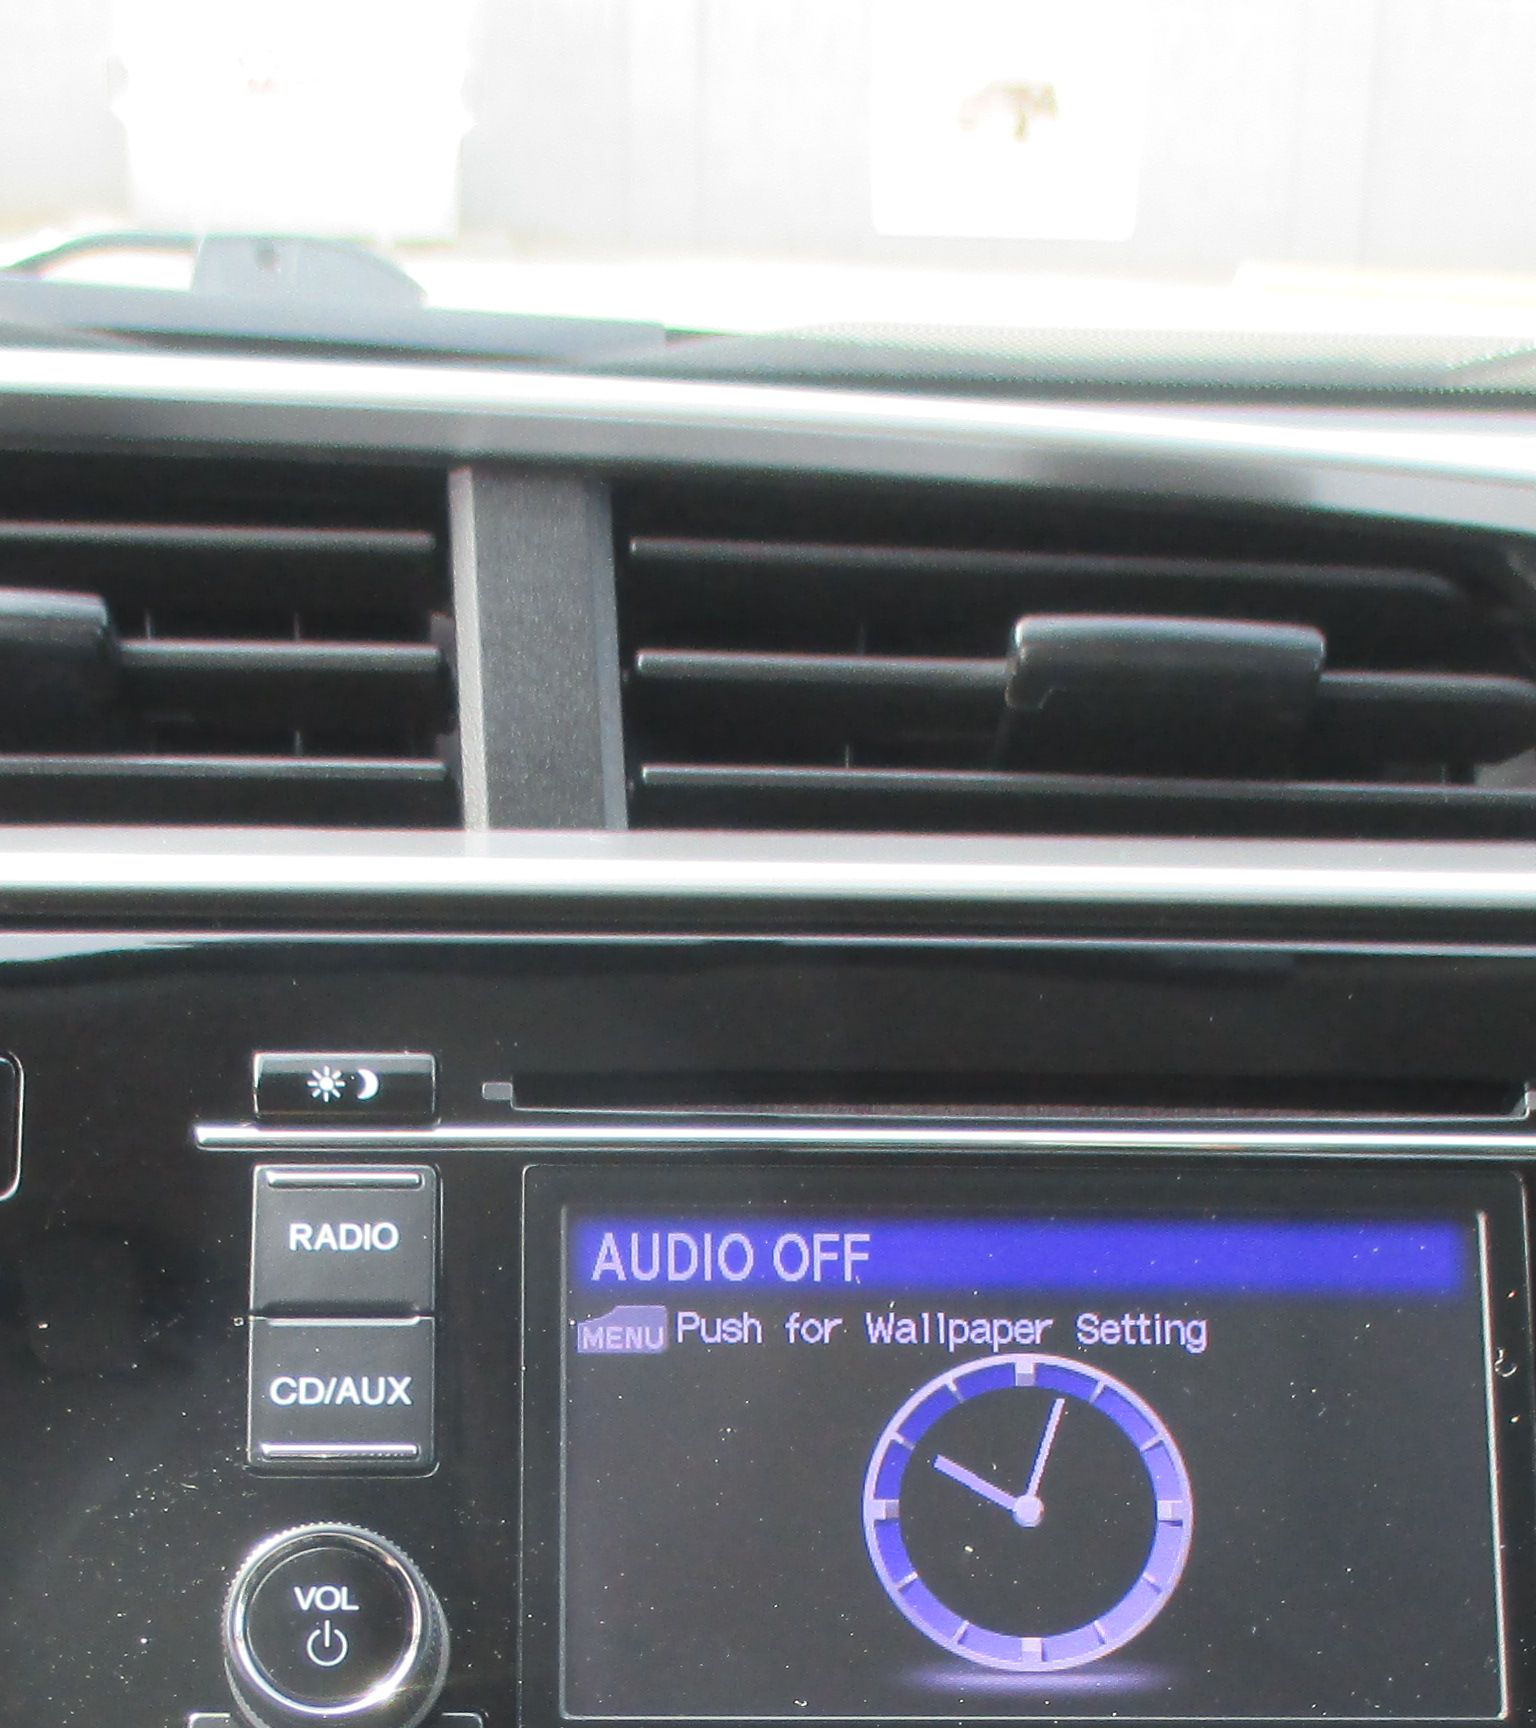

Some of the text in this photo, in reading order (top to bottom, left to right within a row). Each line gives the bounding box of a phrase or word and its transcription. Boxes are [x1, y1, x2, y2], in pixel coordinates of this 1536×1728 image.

[288, 1220, 399, 1251] RADIO
[591, 1231, 871, 1283] AUDIO OFF
[582, 1311, 1209, 1352] MENU Push for Wallpaper Setting
[268, 1375, 412, 1406] CD/AUX
[293, 1585, 360, 1612] VOL
